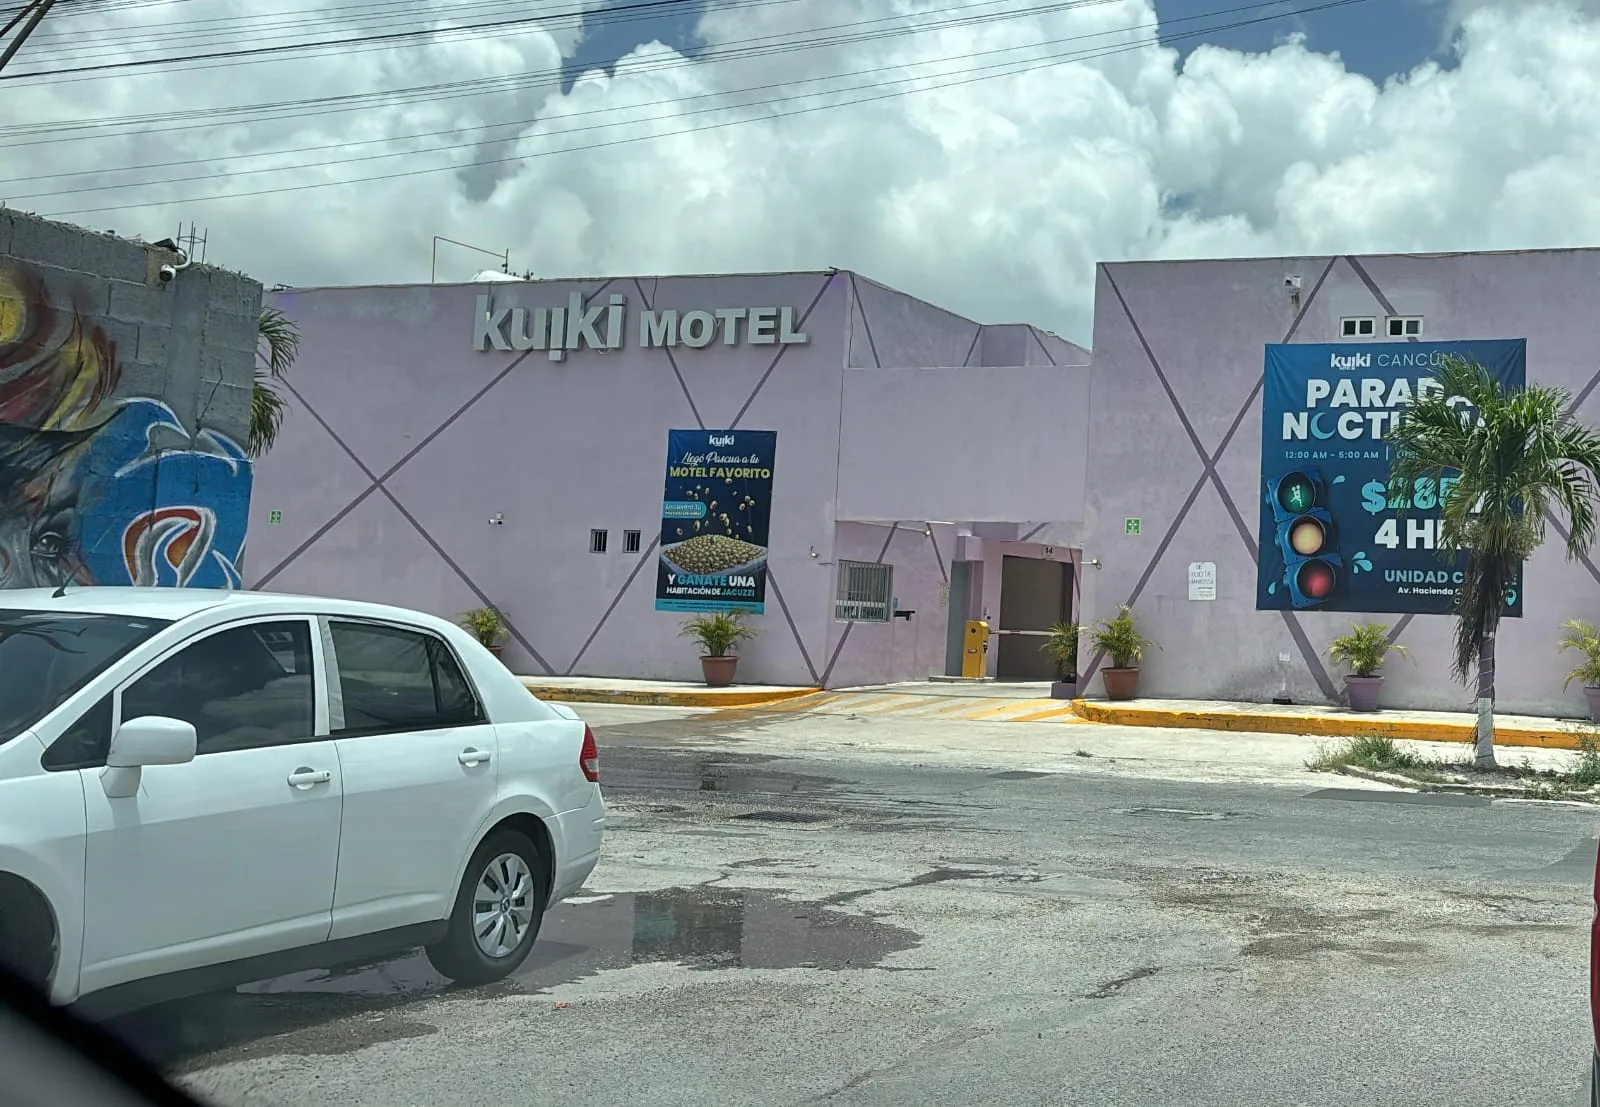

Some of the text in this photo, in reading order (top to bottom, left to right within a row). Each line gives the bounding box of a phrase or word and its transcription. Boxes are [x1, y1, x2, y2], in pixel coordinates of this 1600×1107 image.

[639, 306, 808, 348] MOTEL
[705, 451, 741, 464] Pascua
[749, 453, 760, 464] tu
[1285, 451, 1310, 460] 12:00
[1312, 451, 1328, 460] AM
[1338, 451, 1361, 460] 5:00
[1363, 451, 1379, 460] AM
[669, 467, 771, 479] MOTEL FAVORITO
[1374, 519, 1399, 549] 4
[667, 574, 676, 585] Y
[728, 576, 756, 588] UNA
[1384, 569, 1449, 584] UNIDAD
[666, 586, 755, 597] HABITACIÓN DE JACUZZI
[1397, 586, 1411, 595] Av.
[1412, 587, 1454, 596] Hacienda
